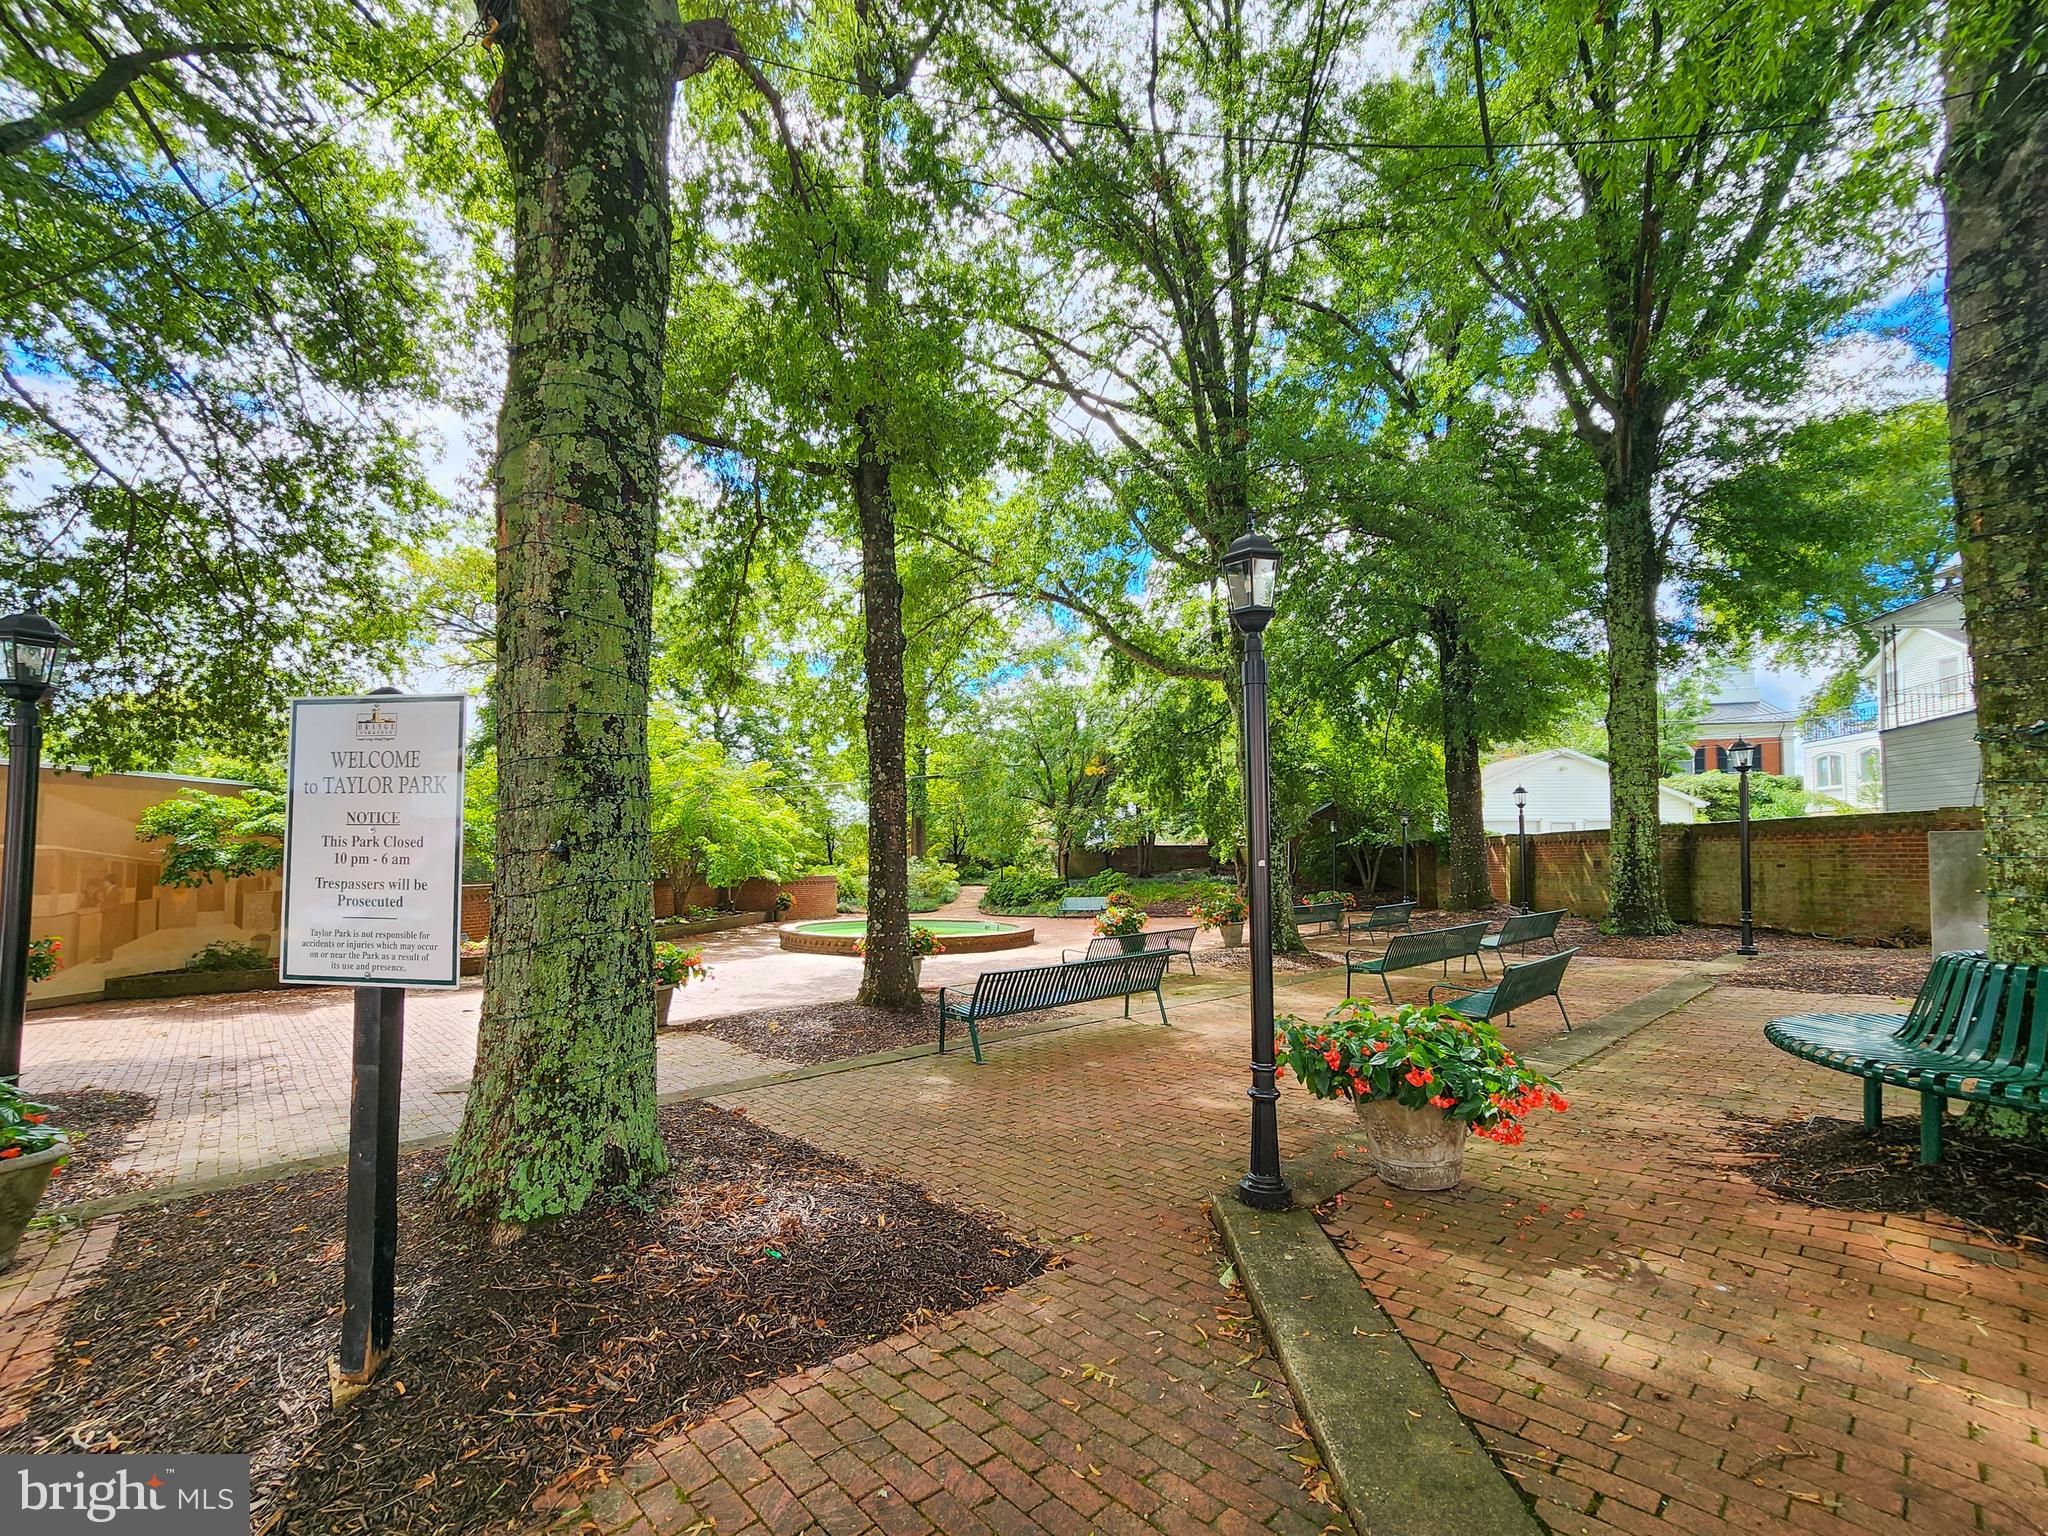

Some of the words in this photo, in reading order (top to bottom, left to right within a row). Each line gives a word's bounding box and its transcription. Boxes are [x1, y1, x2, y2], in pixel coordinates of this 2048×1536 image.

[331, 751, 420, 768] WELCOME
[304, 781, 318, 794] to
[323, 776, 393, 794] TAYLOR
[399, 776, 447, 793] PARK
[346, 812, 400, 824] NOTICE
[321, 835, 347, 848] This
[352, 836, 380, 848] Park
[384, 836, 424, 848] Closed
[334, 853, 347, 864] 10
[351, 855, 369, 867] pm
[382, 853, 388, 865] 6
[392, 855, 410, 865] am
[315, 877, 384, 892] Trespassers
[389, 879, 409, 890] will
[414, 879, 428, 890] be
[338, 895, 403, 907] Prosecuted
[310, 929, 332, 938] Taylor
[375, 931, 417, 940] responsible
[346, 941, 374, 949] injuries
[400, 943, 415, 951] may
